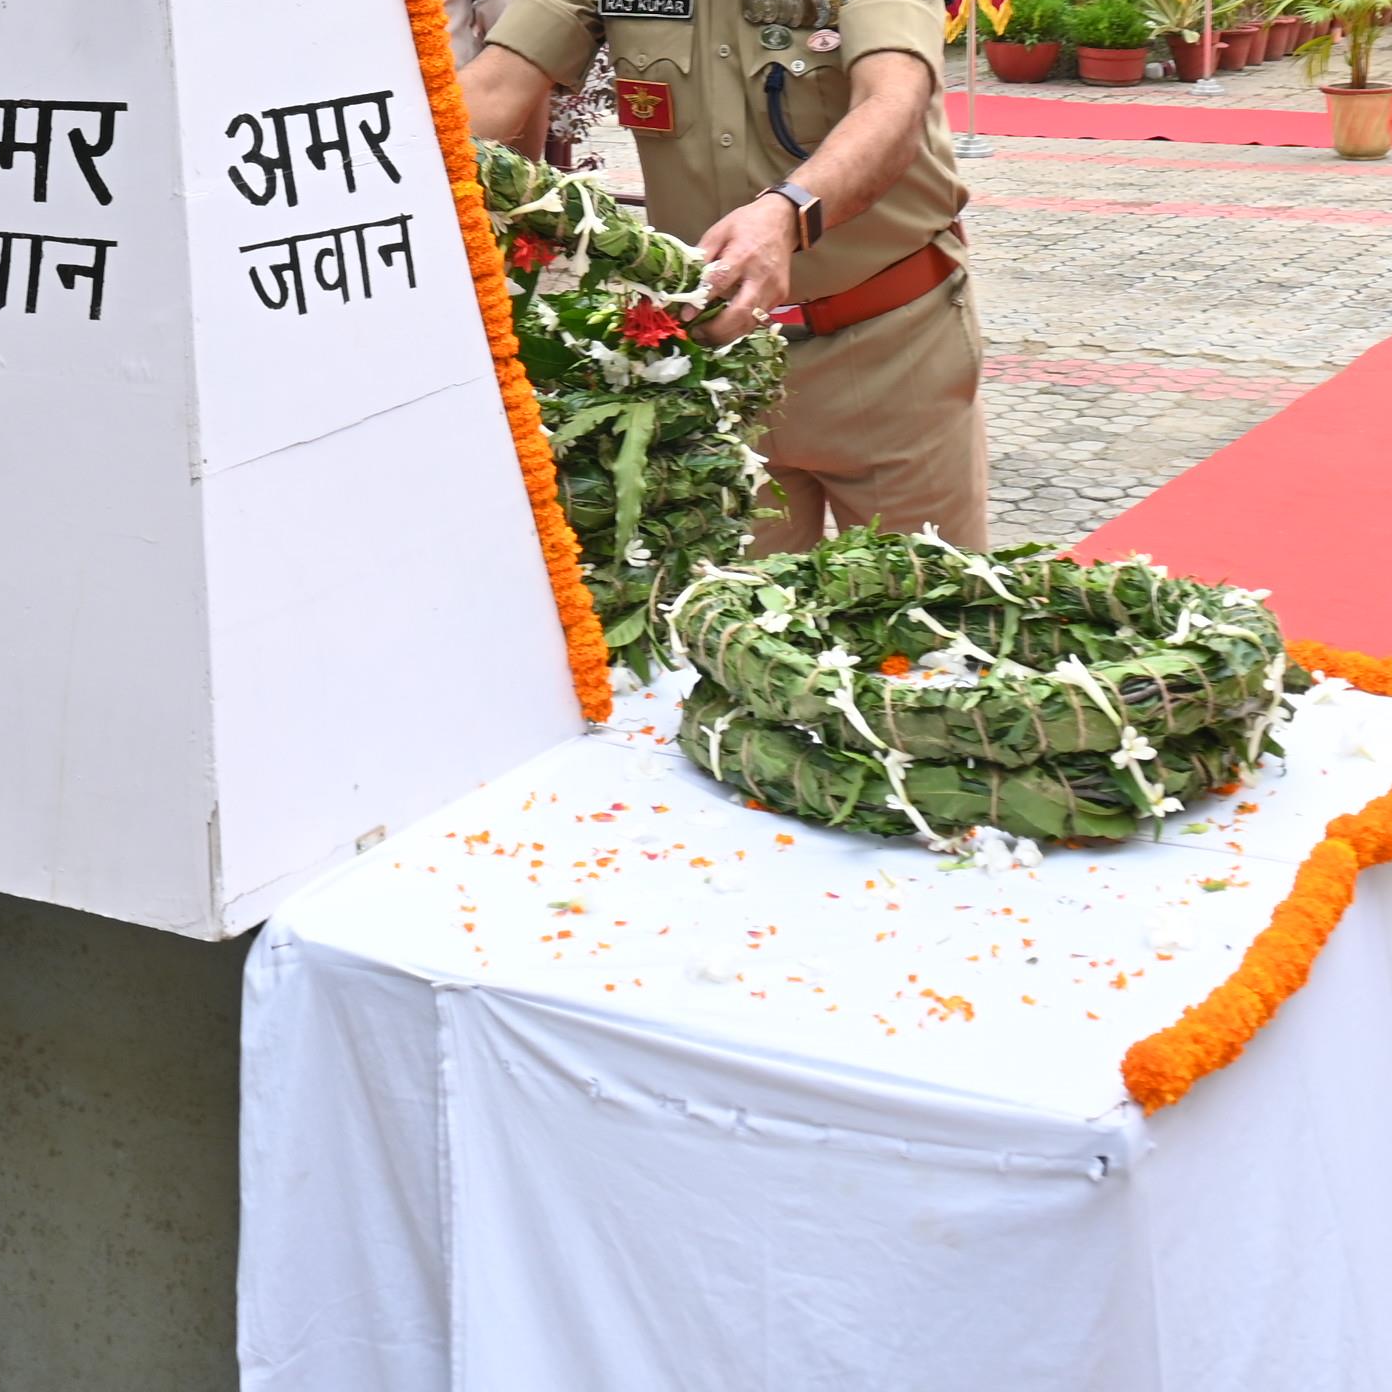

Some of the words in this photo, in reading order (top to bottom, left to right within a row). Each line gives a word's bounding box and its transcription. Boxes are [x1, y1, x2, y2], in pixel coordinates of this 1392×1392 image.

[637, 0, 685, 14] KUMAR
[225, 90, 402, 208] अमर
[239, 213, 417, 315] जवान
